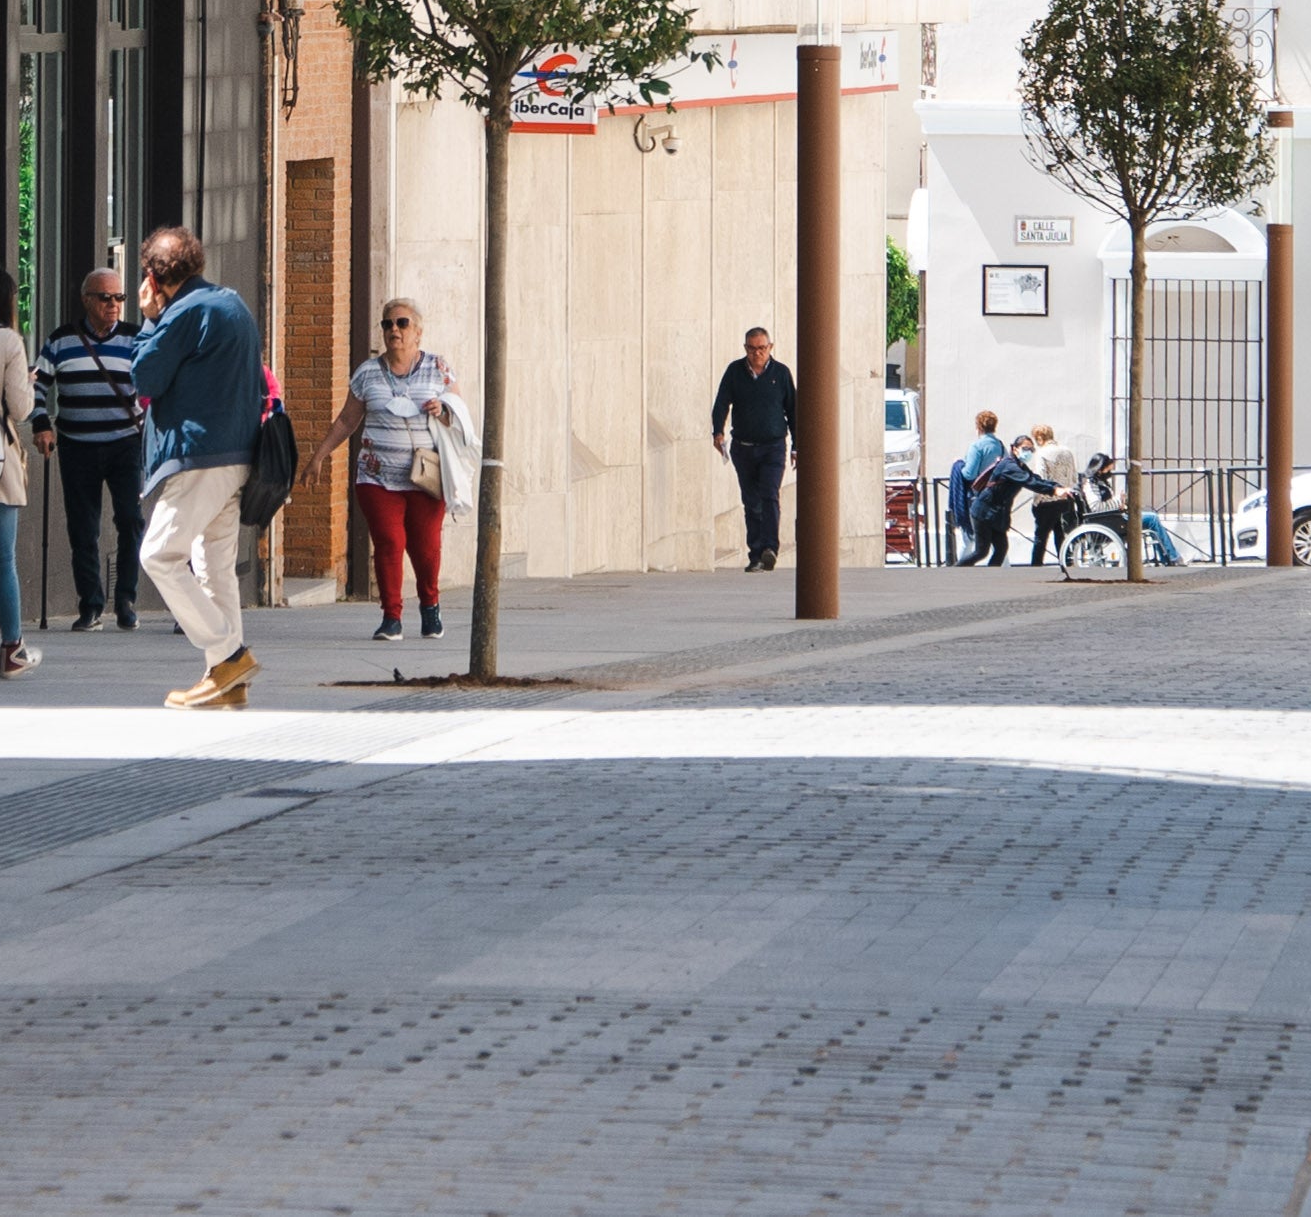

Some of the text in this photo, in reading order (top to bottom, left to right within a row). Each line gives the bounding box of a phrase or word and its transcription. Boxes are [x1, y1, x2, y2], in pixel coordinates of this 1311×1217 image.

[514, 99, 585, 121] iberCaja
[1033, 221, 1056, 231] CALLE
[1020, 231, 1068, 242] SANTA JULIA
